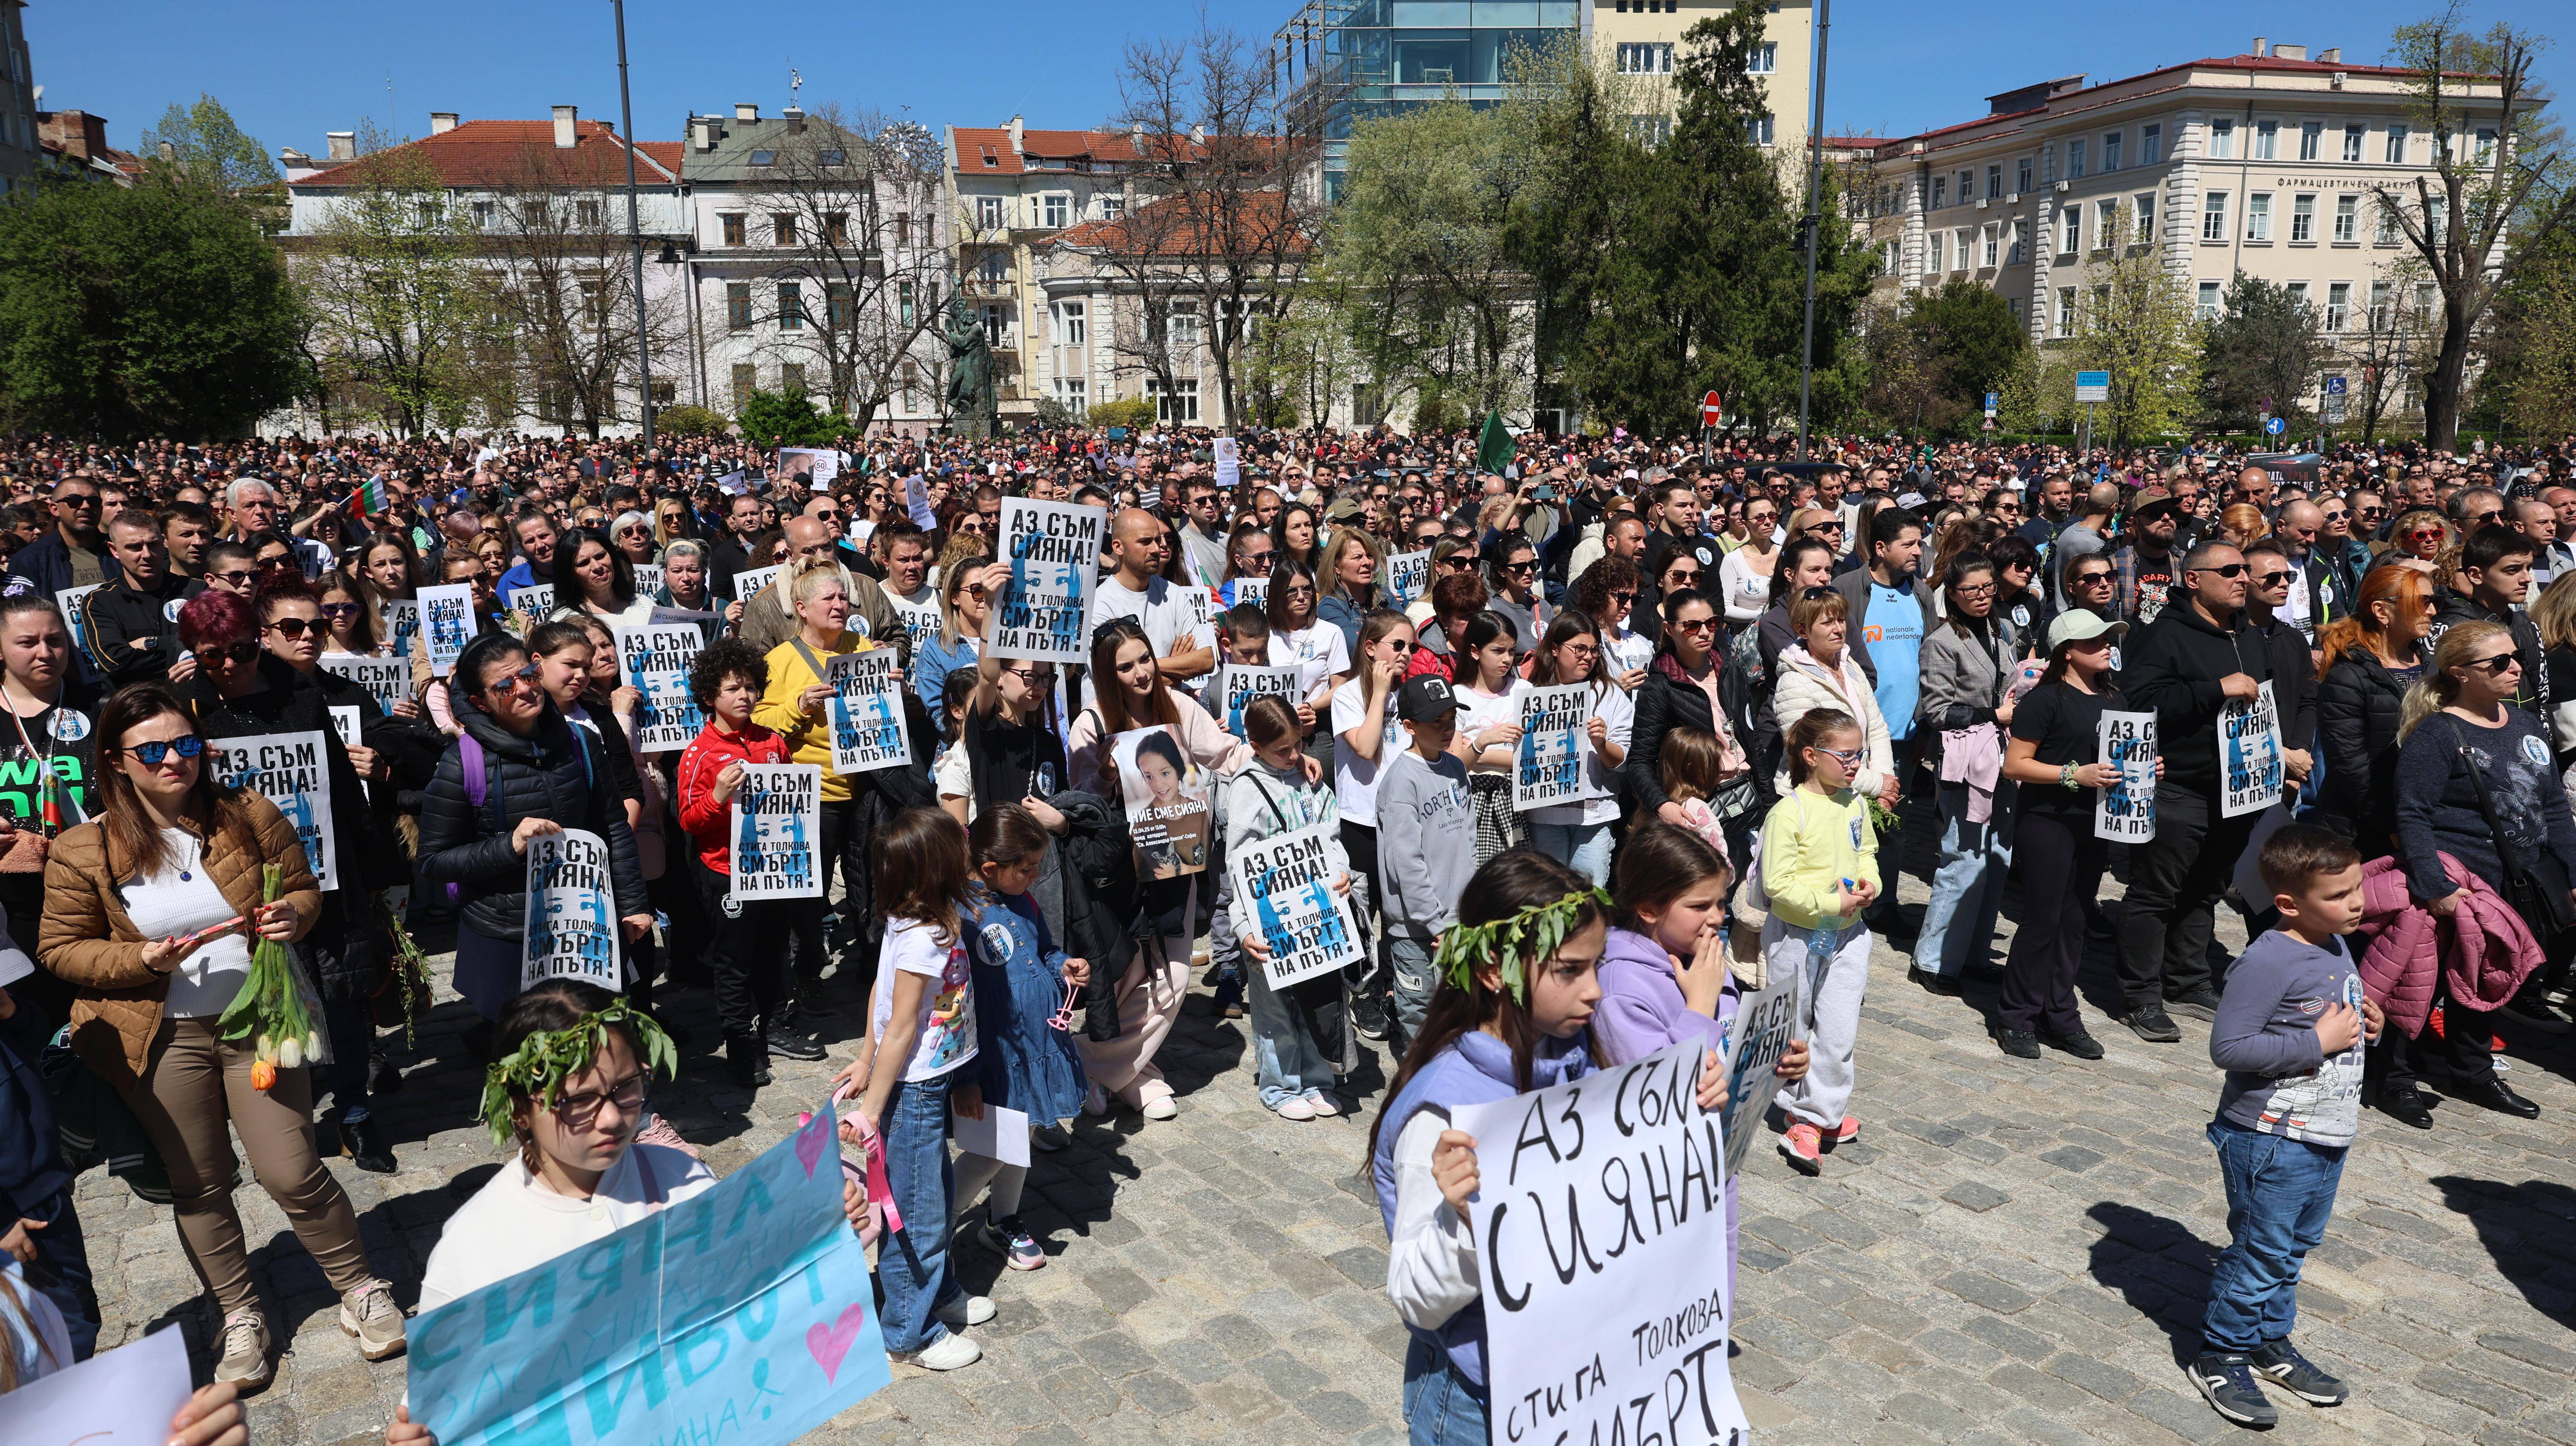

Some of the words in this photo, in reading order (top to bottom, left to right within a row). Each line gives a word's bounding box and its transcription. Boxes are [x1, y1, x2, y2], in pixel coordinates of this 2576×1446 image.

[2278, 177, 2369, 188] ФАРМАЦЕВТИЧЕН
[2377, 180, 2417, 190] ФАКУЛТ
[1011, 509, 1038, 534] АЗ
[1047, 512, 1096, 540] СЪМ
[1009, 533, 1093, 565] СИЯНА!
[1392, 560, 1408, 575] АЗ
[1413, 556, 1428, 571] СЪ
[635, 570, 658, 583] ЪМ
[742, 577, 759, 594] АЗ
[1393, 570, 1428, 590] СИЯН
[1003, 591, 1036, 605] СТИГА
[1041, 594, 1084, 608] ТОЛКОВА
[1241, 585, 1257, 599] АЗ
[67, 594, 82, 610] АЗ
[428, 599, 440, 611] АЗ
[442, 598, 464, 609] СЪМ
[517, 594, 535, 611] АЗ
[396, 606, 417, 621] АЗ
[429, 608, 465, 622] СИЯНА!
[899, 610, 915, 626] АЗ
[921, 613, 942, 628] СЪ
[625, 634, 646, 653] АЗ
[653, 632, 697, 651] СЪМ
[998, 630, 1018, 648] НА
[434, 647, 444, 655] НА
[329, 666, 349, 680] АЗ
[358, 665, 400, 682] СЪМ
[830, 662, 848, 680] АЗ
[854, 657, 890, 677] СЪМ
[830, 674, 892, 699] СИЯНА!
[1229, 673, 1249, 691] АЗ
[1256, 673, 1295, 692] СЪМ
[644, 696, 660, 707] ИГА
[665, 696, 693, 706] ТОЛКО
[1522, 696, 1541, 714] АЗ
[1548, 691, 1584, 712] СЪМ
[2225, 699, 2245, 720] АЗ
[835, 721, 860, 731] СТИГА
[864, 717, 898, 729] ТОЛКОВА
[1521, 710, 1584, 735] СИЯНА!
[2109, 720, 2134, 740] АЗ
[2225, 708, 2275, 740] СИЯНА!
[639, 729, 657, 744] НА
[218, 748, 249, 774] АЗ
[259, 743, 316, 770] СЪМ
[841, 750, 857, 766] НА
[1520, 756, 1543, 767] СТИГА
[1546, 751, 1580, 763] ТОЛКОВА
[2108, 740, 2156, 762] СИЯН
[2228, 761, 2251, 774] СТИГА
[2254, 752, 2279, 766] ТОЛКОВА
[741, 773, 763, 793] АЗ
[772, 773, 811, 793] СЪМ
[1520, 787, 1534, 802] НА
[2230, 793, 2245, 808] НА
[741, 794, 811, 815] СИЯНА!
[1130, 808, 1154, 823] НИЕ
[1154, 806, 1175, 820] СМЕ
[1175, 799, 1208, 816] СИЯНА
[1448, 817, 1464, 827] Winnipe
[2105, 816, 2122, 833] НА
[738, 842, 767, 852] СТИГА
[771, 841, 810, 851] ТОЛКОВА
[1145, 838, 1170, 847] Александър
[531, 840, 555, 868] АЗ
[566, 839, 608, 875] СЪМ
[1243, 853, 1267, 878] АЗ
[1273, 835, 1324, 867] СЪМ
[531, 864, 611, 898] СИЯНА!
[740, 875, 758, 891] НА
[1247, 856, 1330, 900] СИЯНА!
[529, 920, 559, 937] СТИГА
[564, 919, 612, 937] ТОЛКОВА
[1262, 920, 1294, 939] СТИГА
[1295, 905, 1341, 928] ТОЛКОВА
[528, 960, 545, 981] НА
[1273, 958, 1296, 978] НА
[1742, 1002, 1767, 1040] АЗ
[1510, 1088, 1583, 1186] АЗ
[1614, 1045, 1707, 1137] СЪМ
[1488, 1120, 1720, 1312] СИЯНА!
[411, 1174, 774, 1371] СИЯНА
[1507, 1352, 1607, 1443] СТИГА
[1633, 1288, 1722, 1367] ТОЛКОВА
